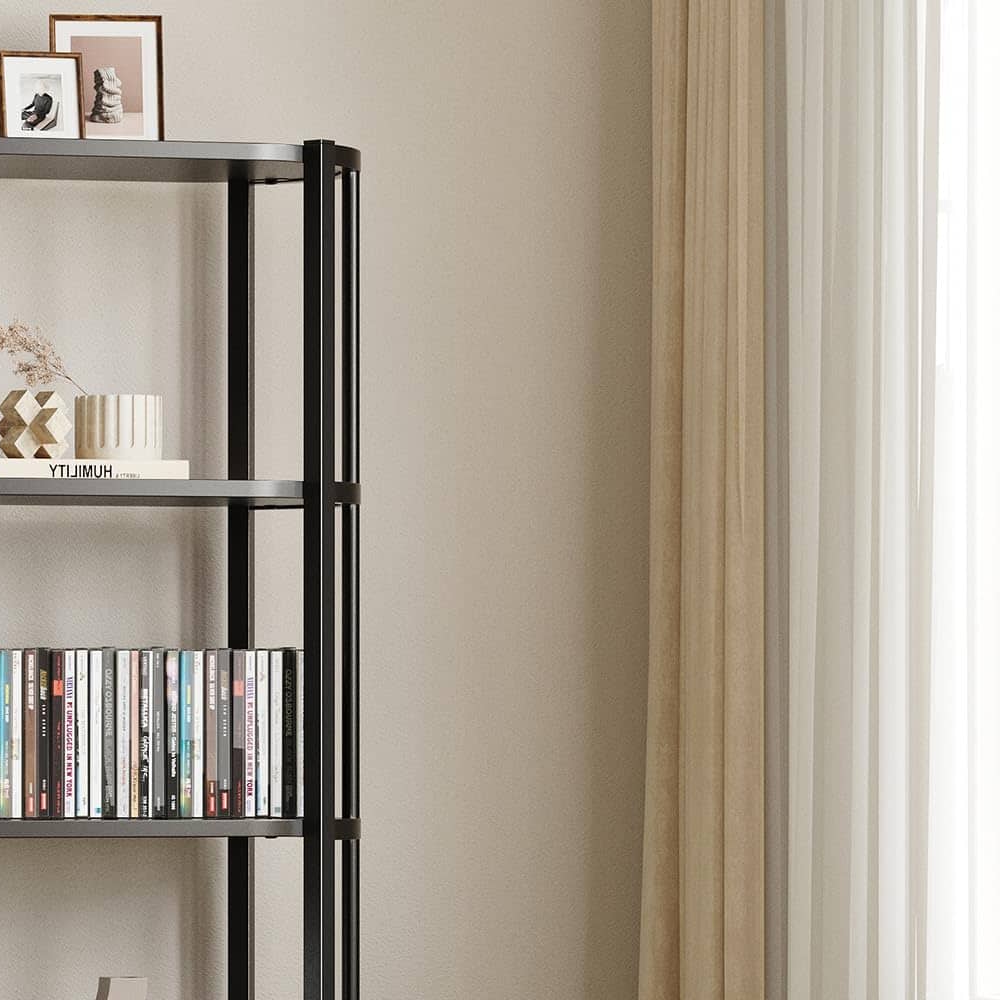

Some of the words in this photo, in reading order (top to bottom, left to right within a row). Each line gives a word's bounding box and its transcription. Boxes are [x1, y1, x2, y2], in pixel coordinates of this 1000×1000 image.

[104, 691, 112, 736] OSBOURNE
[246, 710, 254, 750] UNPLUGGED
[246, 762, 254, 776] NEW
[246, 779, 254, 796] YORK
